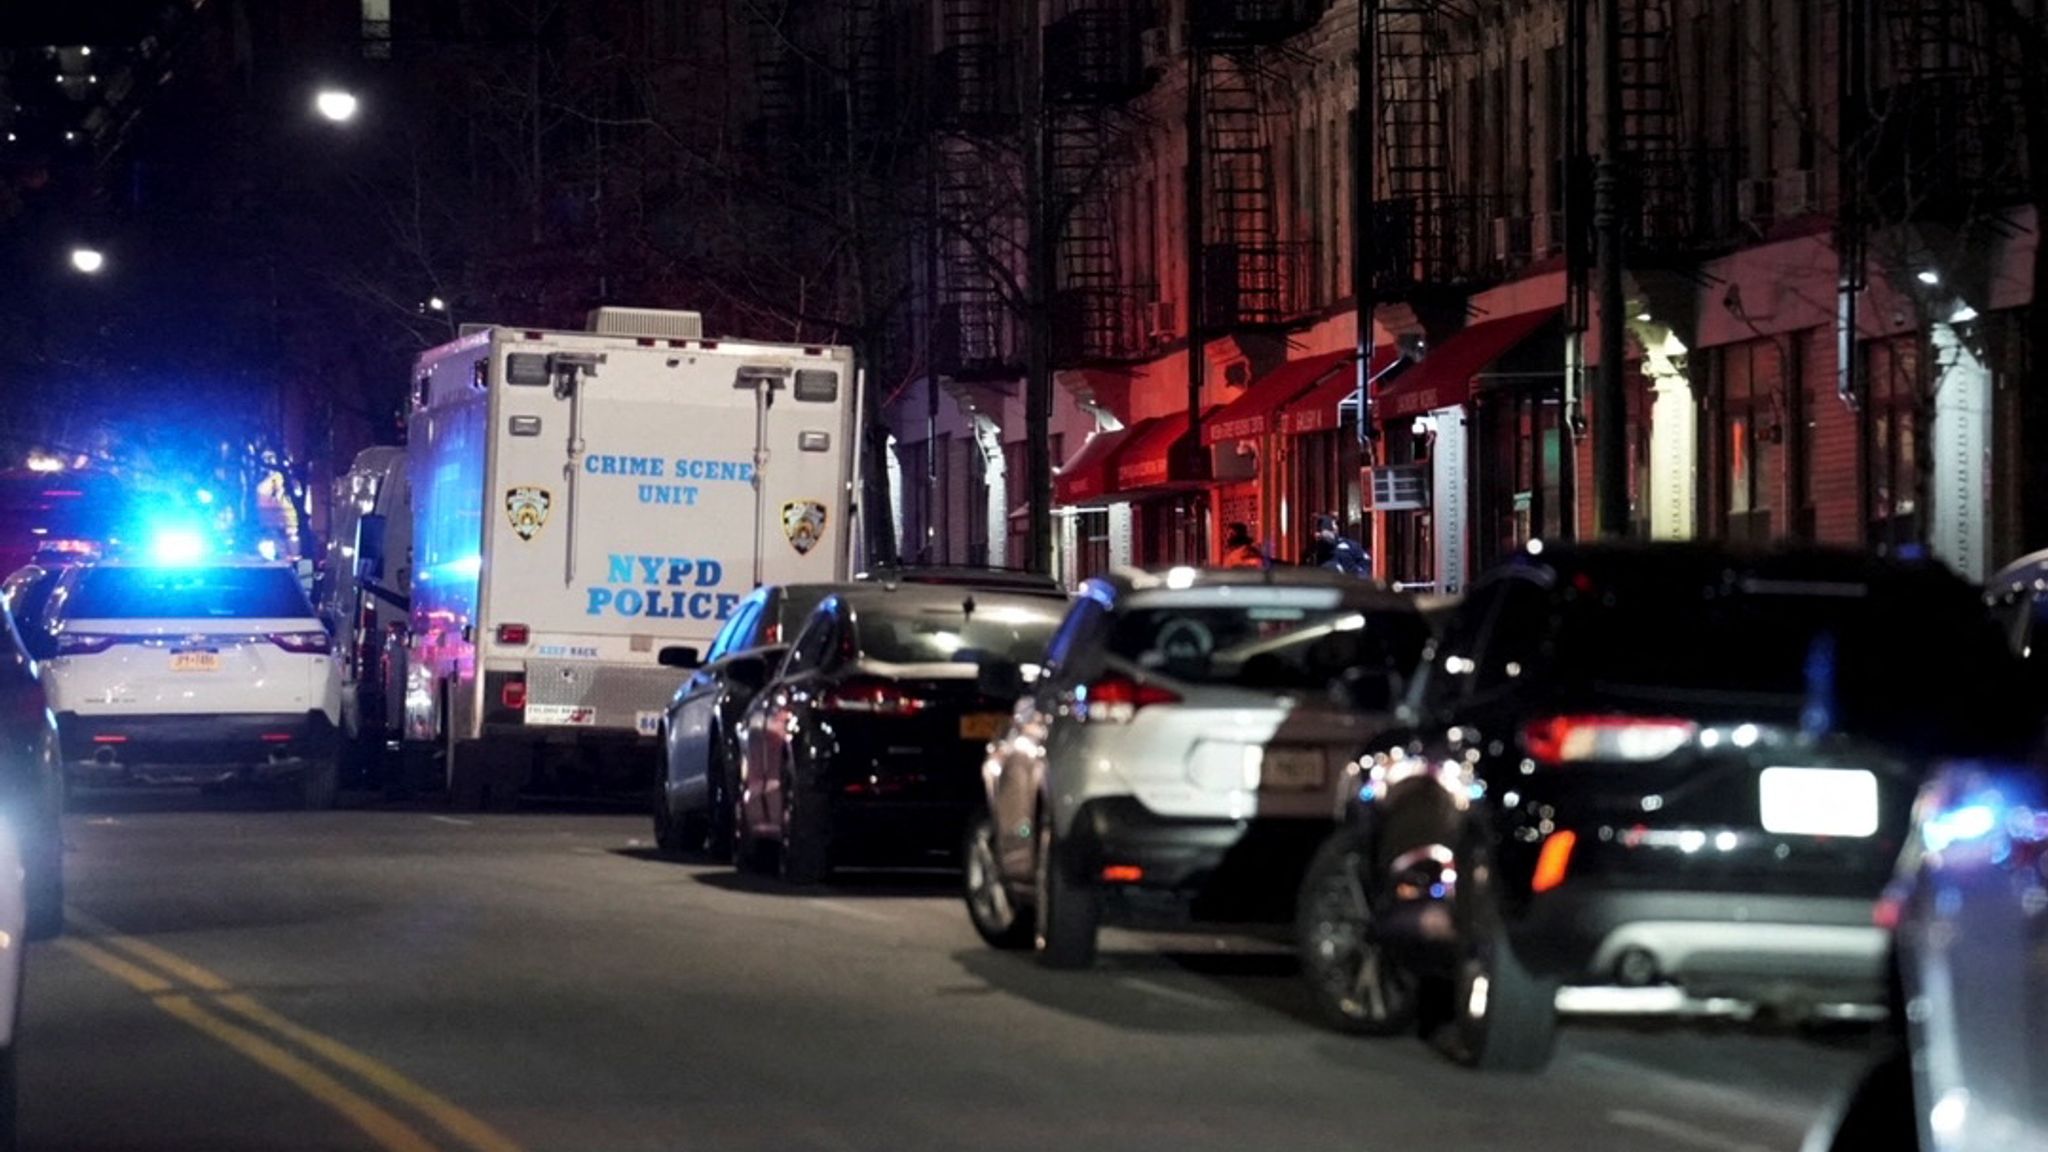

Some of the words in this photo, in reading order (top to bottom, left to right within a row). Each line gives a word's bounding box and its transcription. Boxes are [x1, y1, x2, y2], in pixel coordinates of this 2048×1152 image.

[585, 455, 664, 477] CRIME
[675, 459, 753, 481] SCENE
[638, 484, 699, 505] UNIT
[607, 554, 723, 587] NYPD
[586, 587, 741, 621] POLICE
